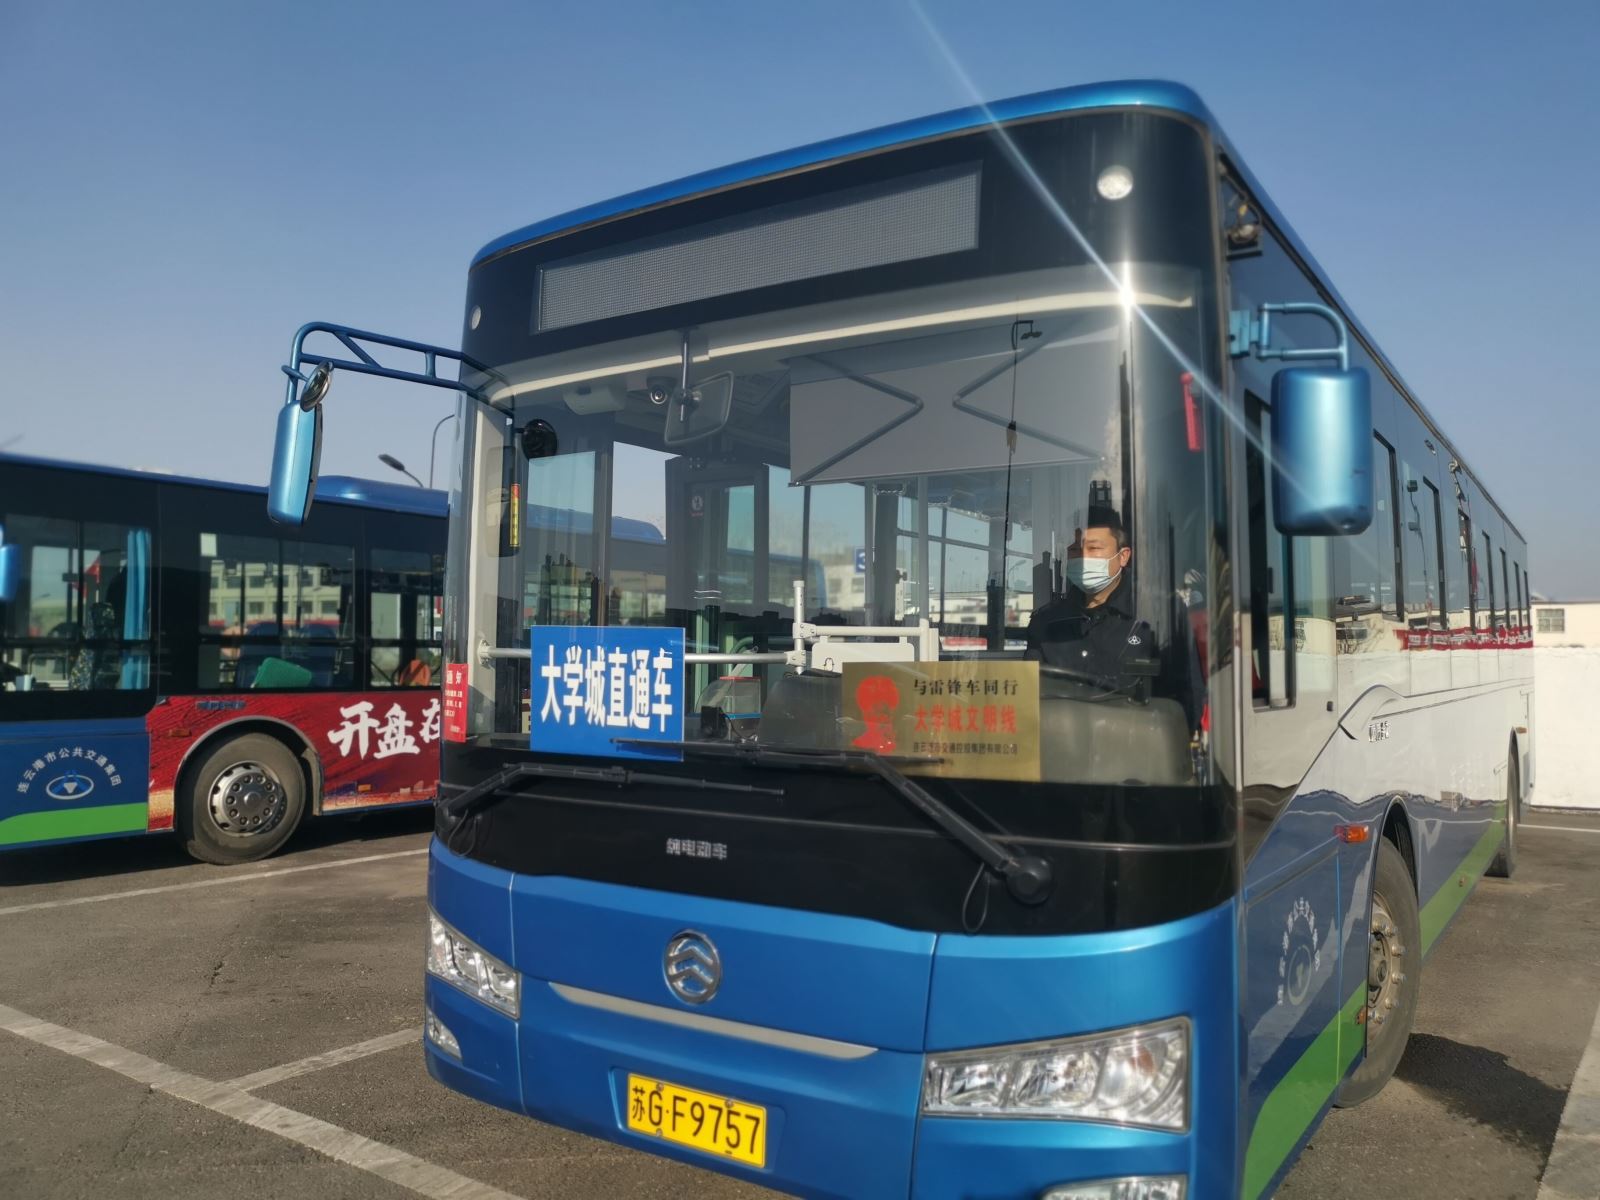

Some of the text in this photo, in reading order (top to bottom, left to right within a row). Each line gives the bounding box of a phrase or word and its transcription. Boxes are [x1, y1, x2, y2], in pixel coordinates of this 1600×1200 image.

[540, 644, 673, 732] 大学城直通车
[913, 679, 1018, 696] 与雷锋车同行
[914, 703, 1018, 735] 大学城文明线
